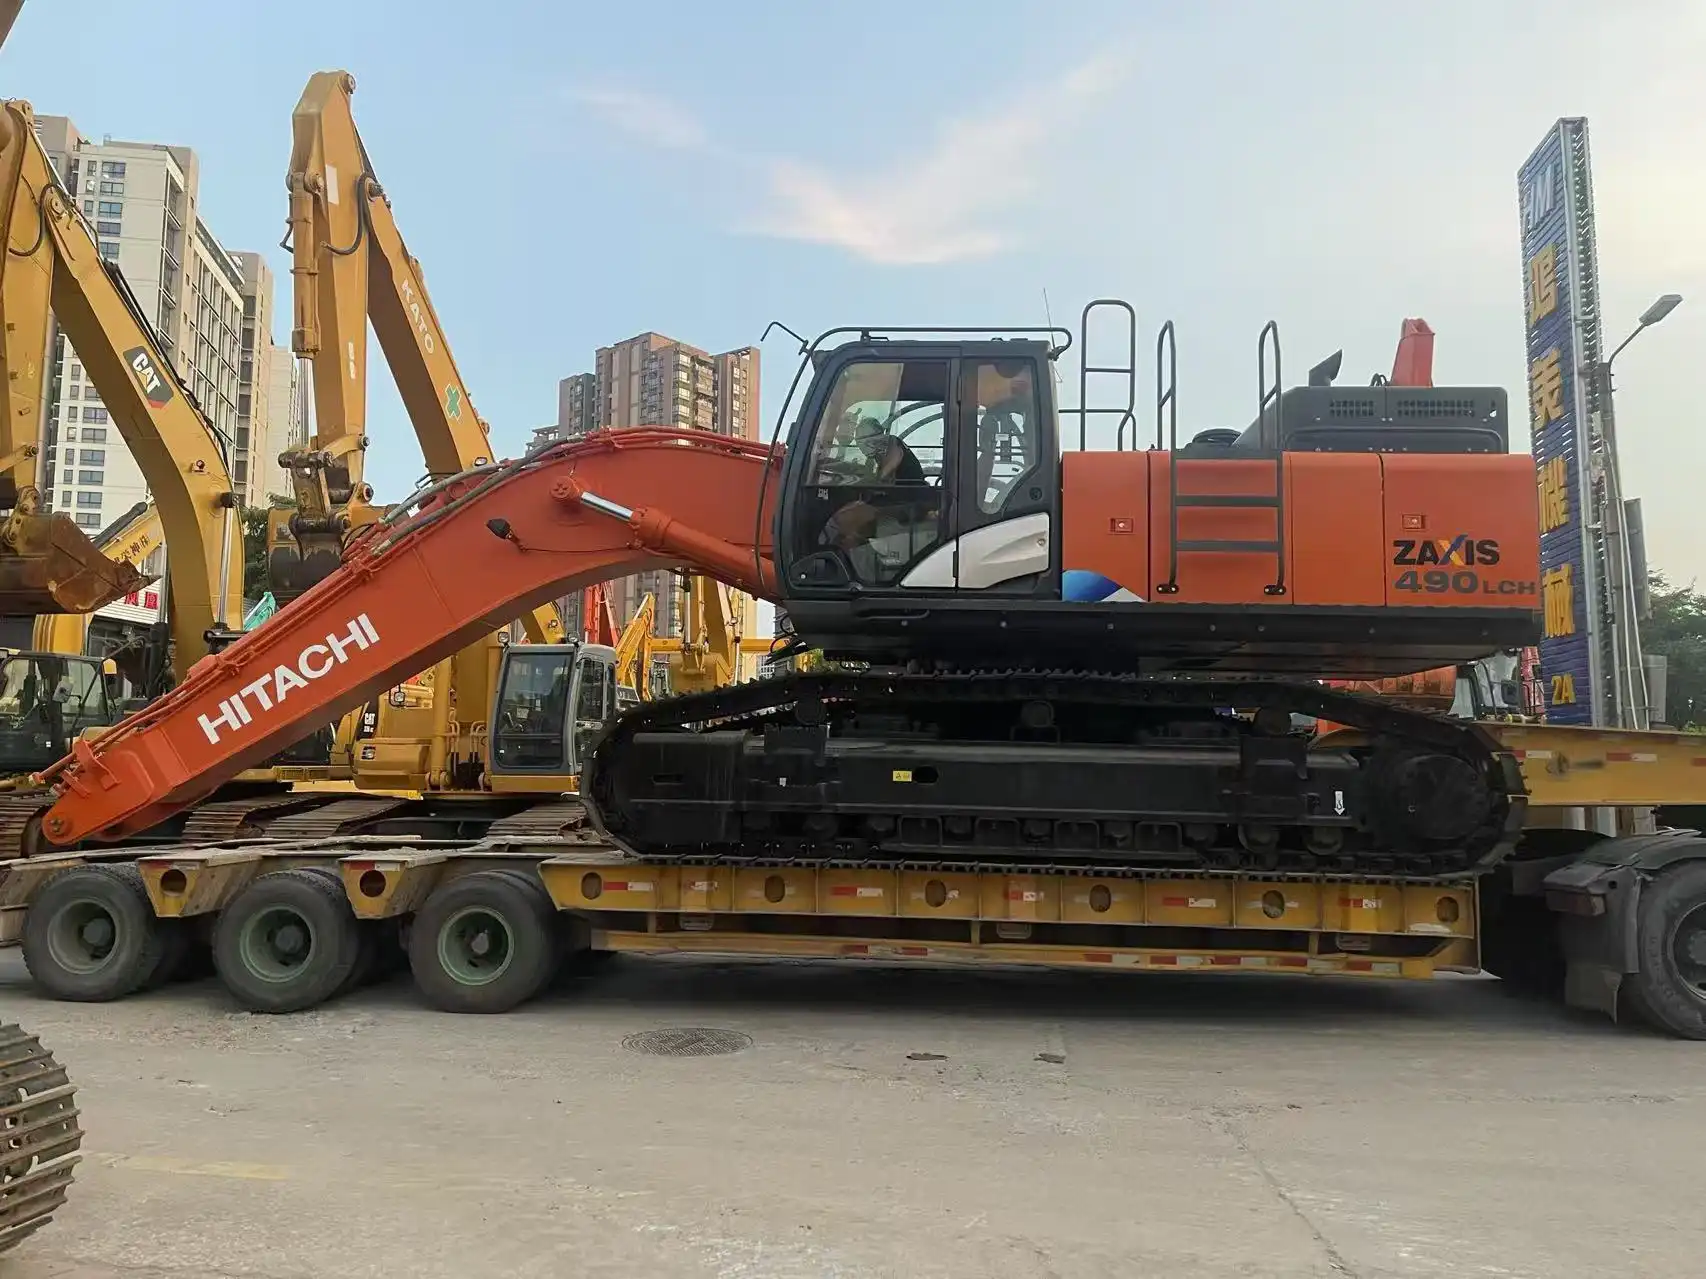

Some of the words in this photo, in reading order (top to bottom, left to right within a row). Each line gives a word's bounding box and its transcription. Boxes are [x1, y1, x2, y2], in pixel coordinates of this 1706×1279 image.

[402, 277, 435, 354] KATO
[132, 352, 161, 394] CAT
[1393, 534, 1500, 567] ZAXIS
[1395, 570, 1478, 594] 490
[1483, 580, 1536, 595] LCH
[197, 613, 380, 745] HITACHI
